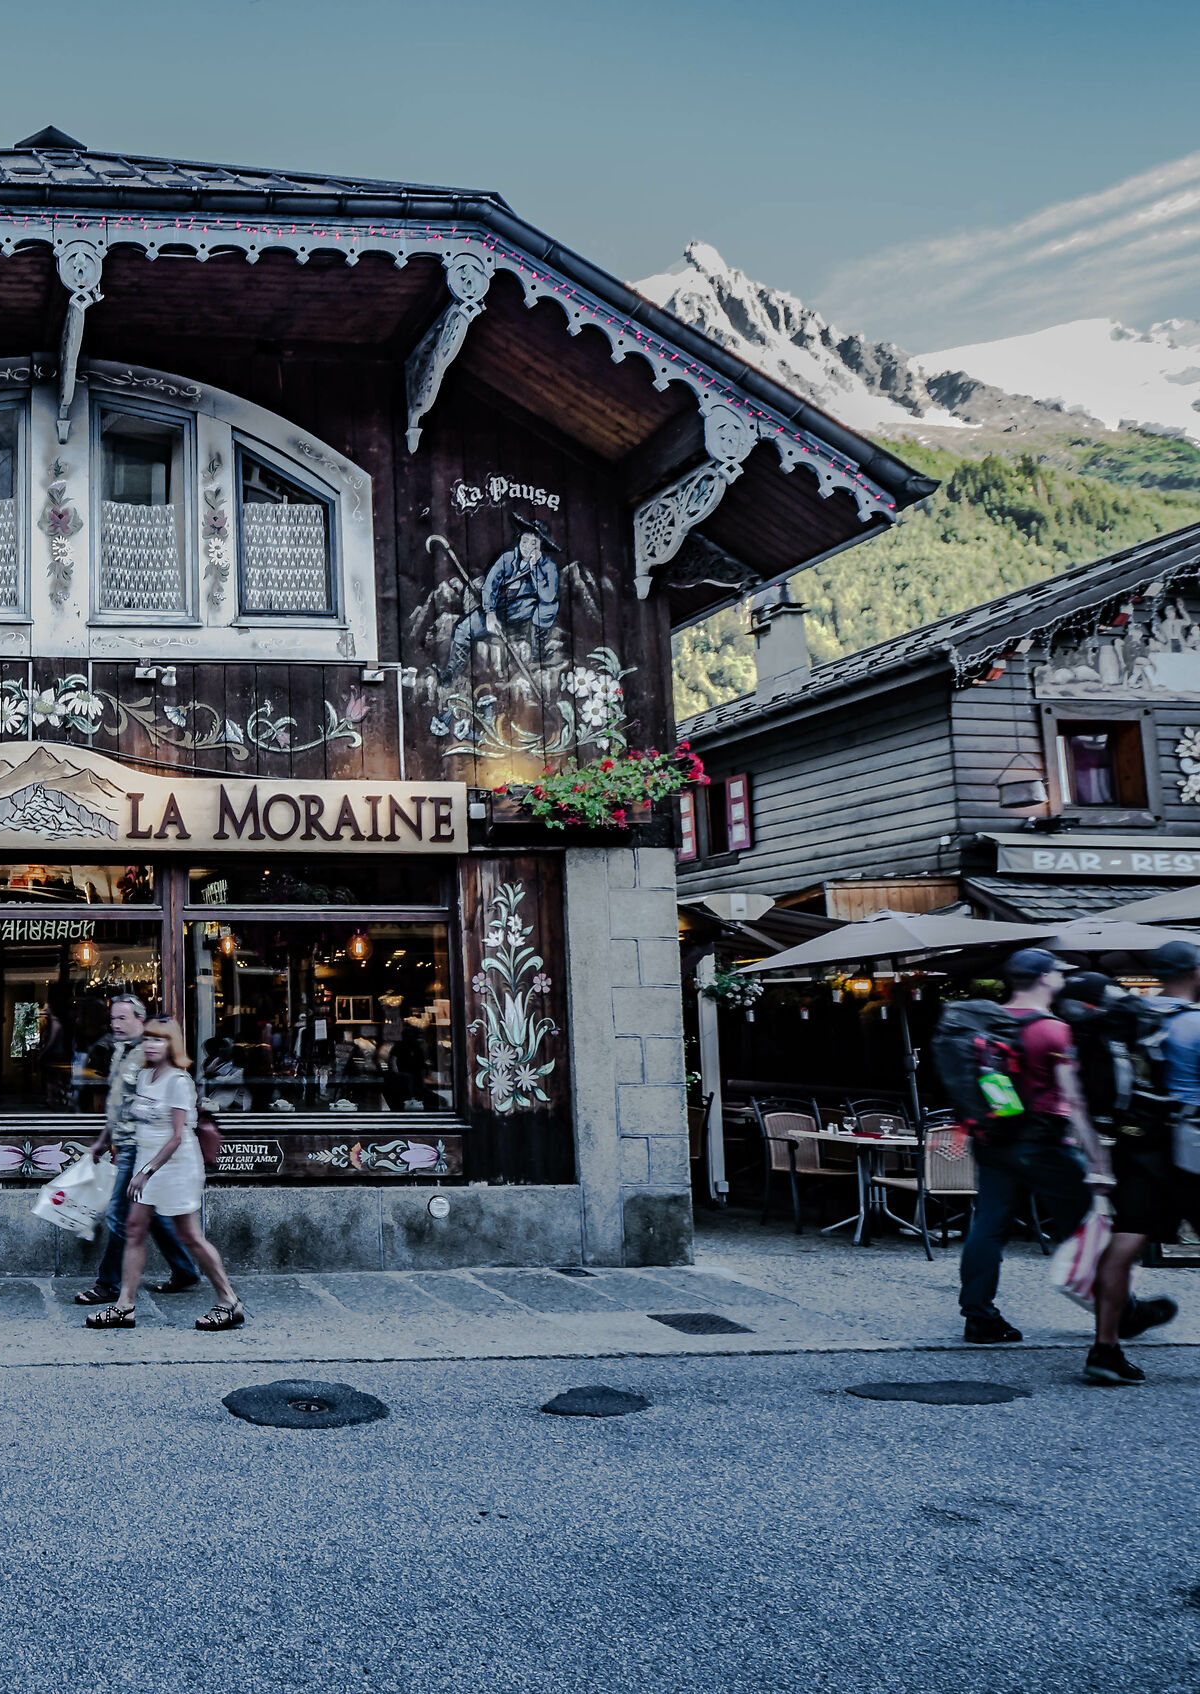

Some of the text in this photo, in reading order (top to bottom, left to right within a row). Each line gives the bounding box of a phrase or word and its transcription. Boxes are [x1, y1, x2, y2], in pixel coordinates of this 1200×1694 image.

[456, 475, 561, 512] La Pause
[125, 792, 192, 840] LA
[212, 783, 456, 843] MORAINE
[1032, 850, 1103, 872] BAR
[216, 1144, 268, 1155] NVENUTI
[218, 1163, 255, 1171] ITALIANI
[254, 1155, 278, 1163] AMICI
